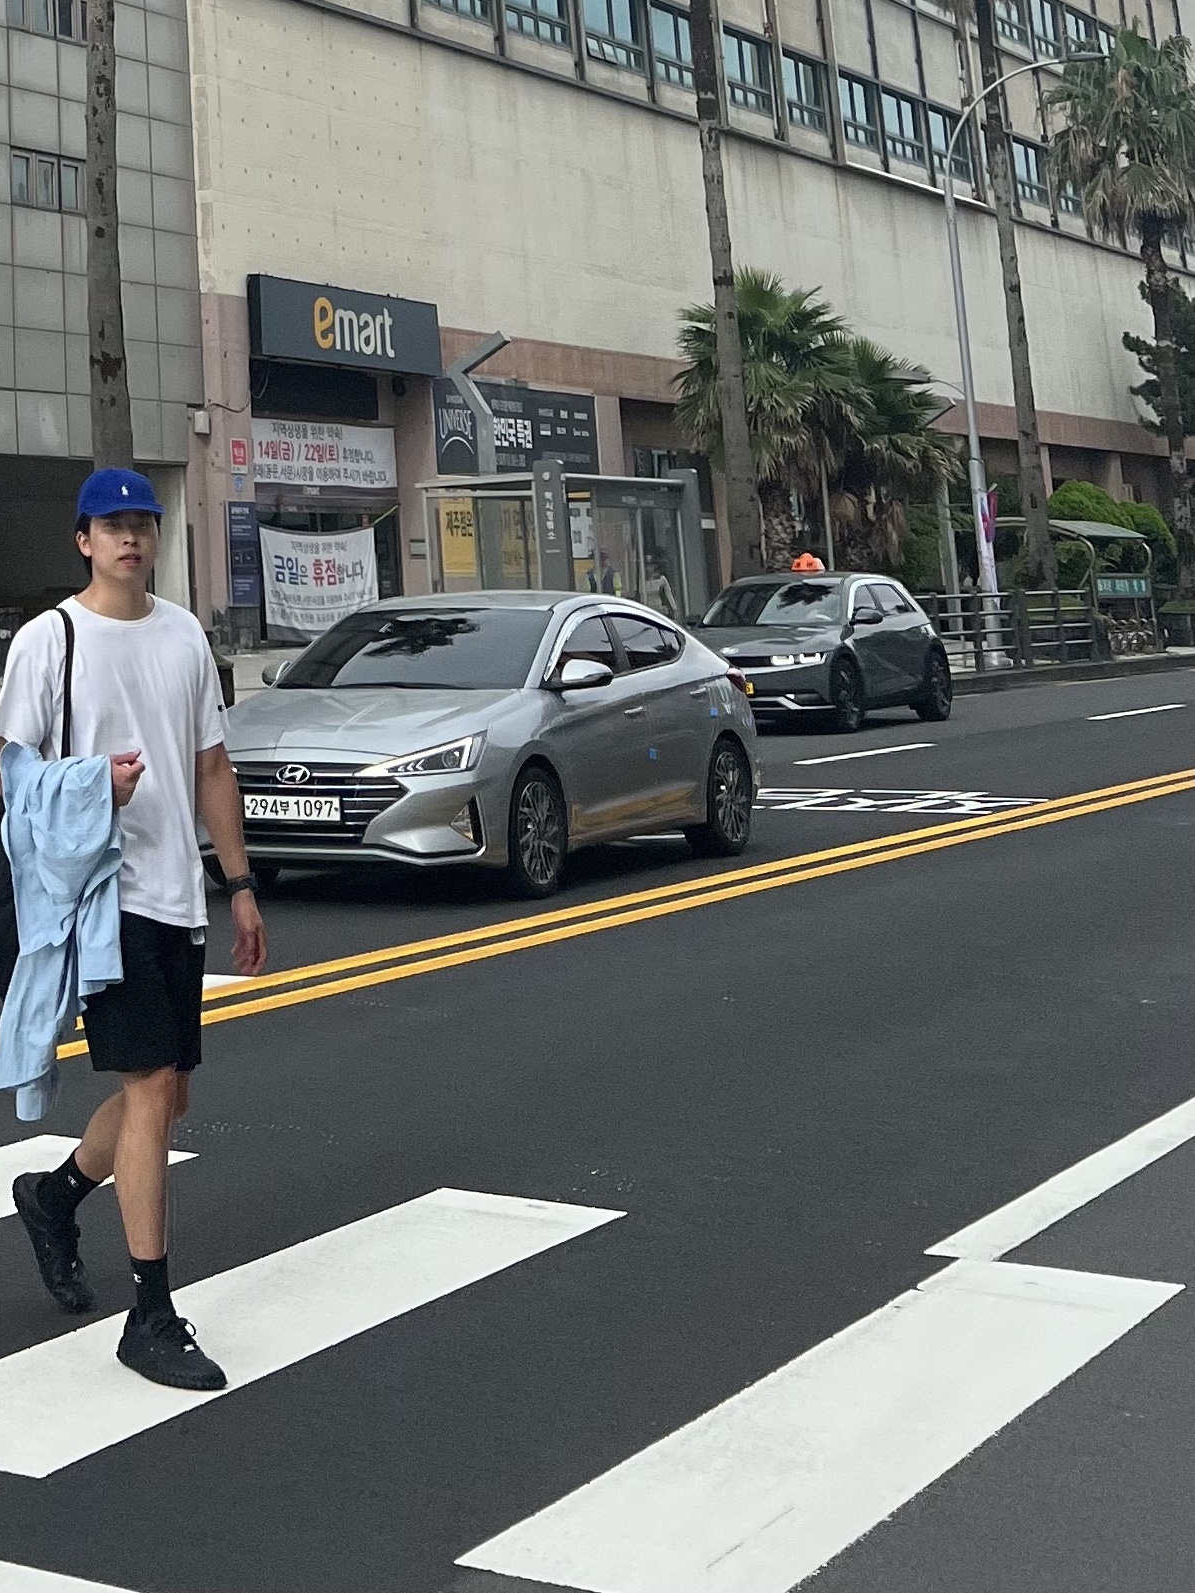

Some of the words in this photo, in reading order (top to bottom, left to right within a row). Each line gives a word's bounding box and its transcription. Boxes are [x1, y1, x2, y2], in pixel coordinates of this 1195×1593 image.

[313, 296, 395, 358] emart
[438, 408, 473, 440] UNIVERSE
[258, 439, 295, 462] 14일(금)
[304, 443, 340, 463] 22일(토)
[274, 554, 309, 586] 금일은
